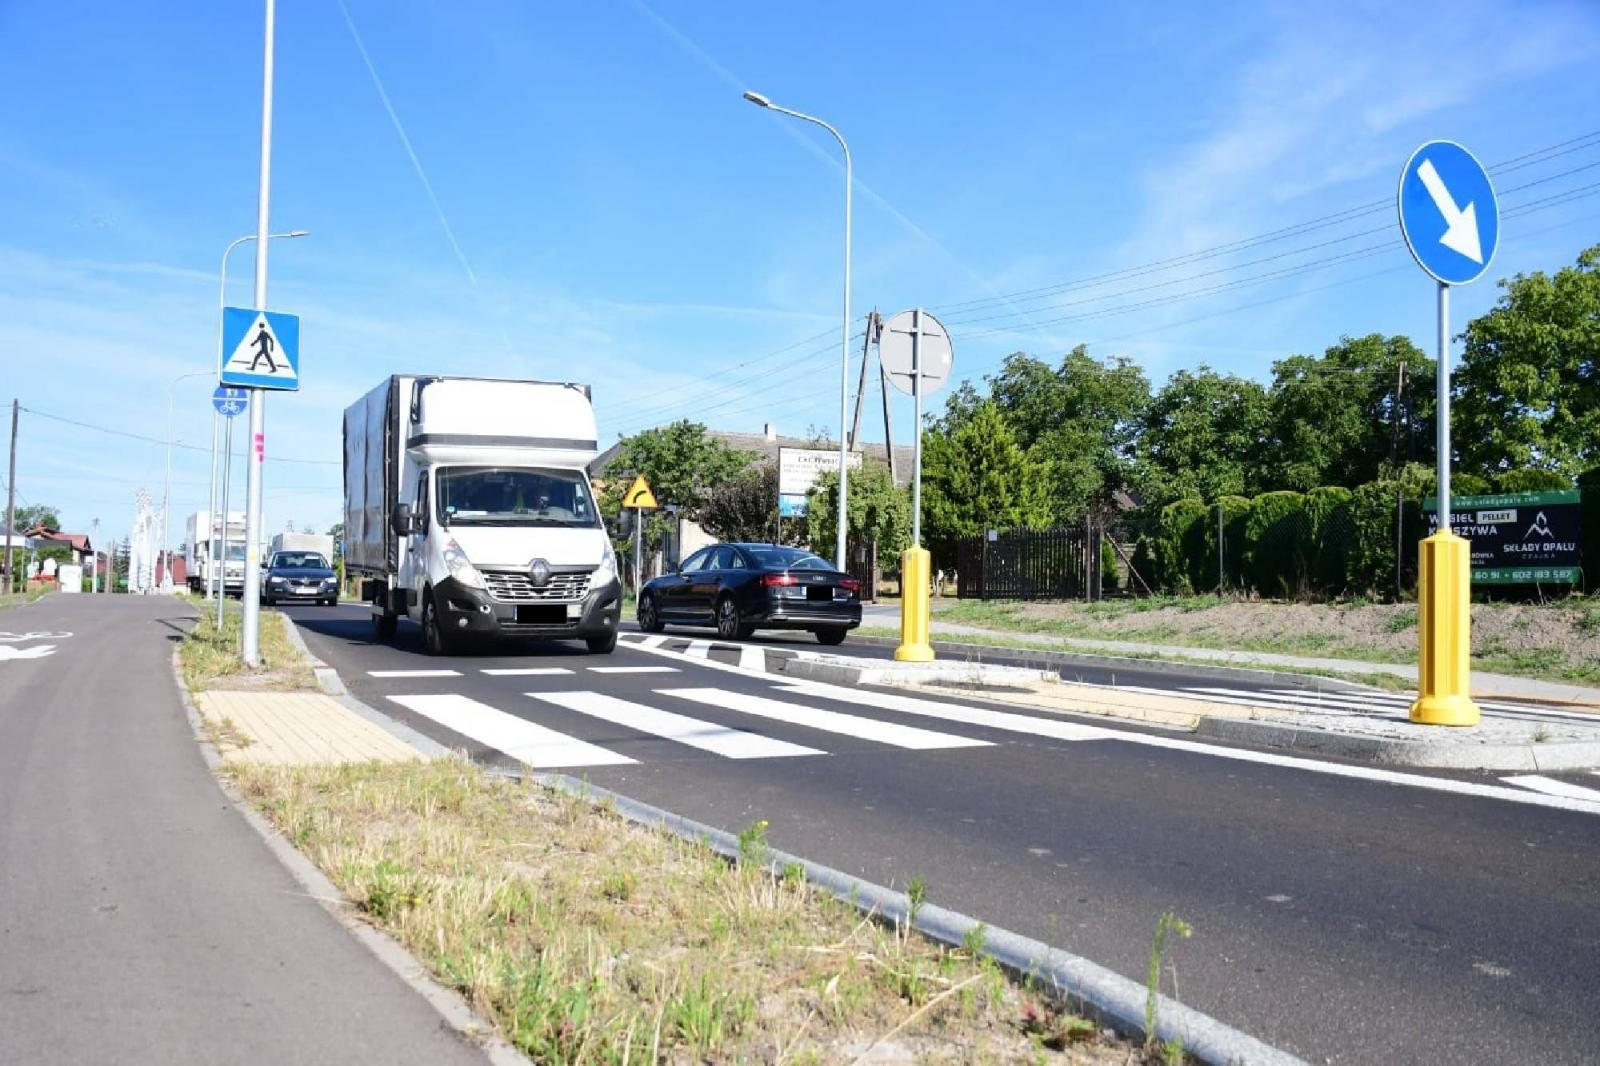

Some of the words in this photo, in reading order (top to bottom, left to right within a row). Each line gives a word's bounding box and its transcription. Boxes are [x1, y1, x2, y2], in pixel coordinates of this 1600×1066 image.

[1428, 513, 1475, 524] WGIEL
[1482, 512, 1511, 521] PELLET
[1428, 525, 1498, 536] KSZYWA
